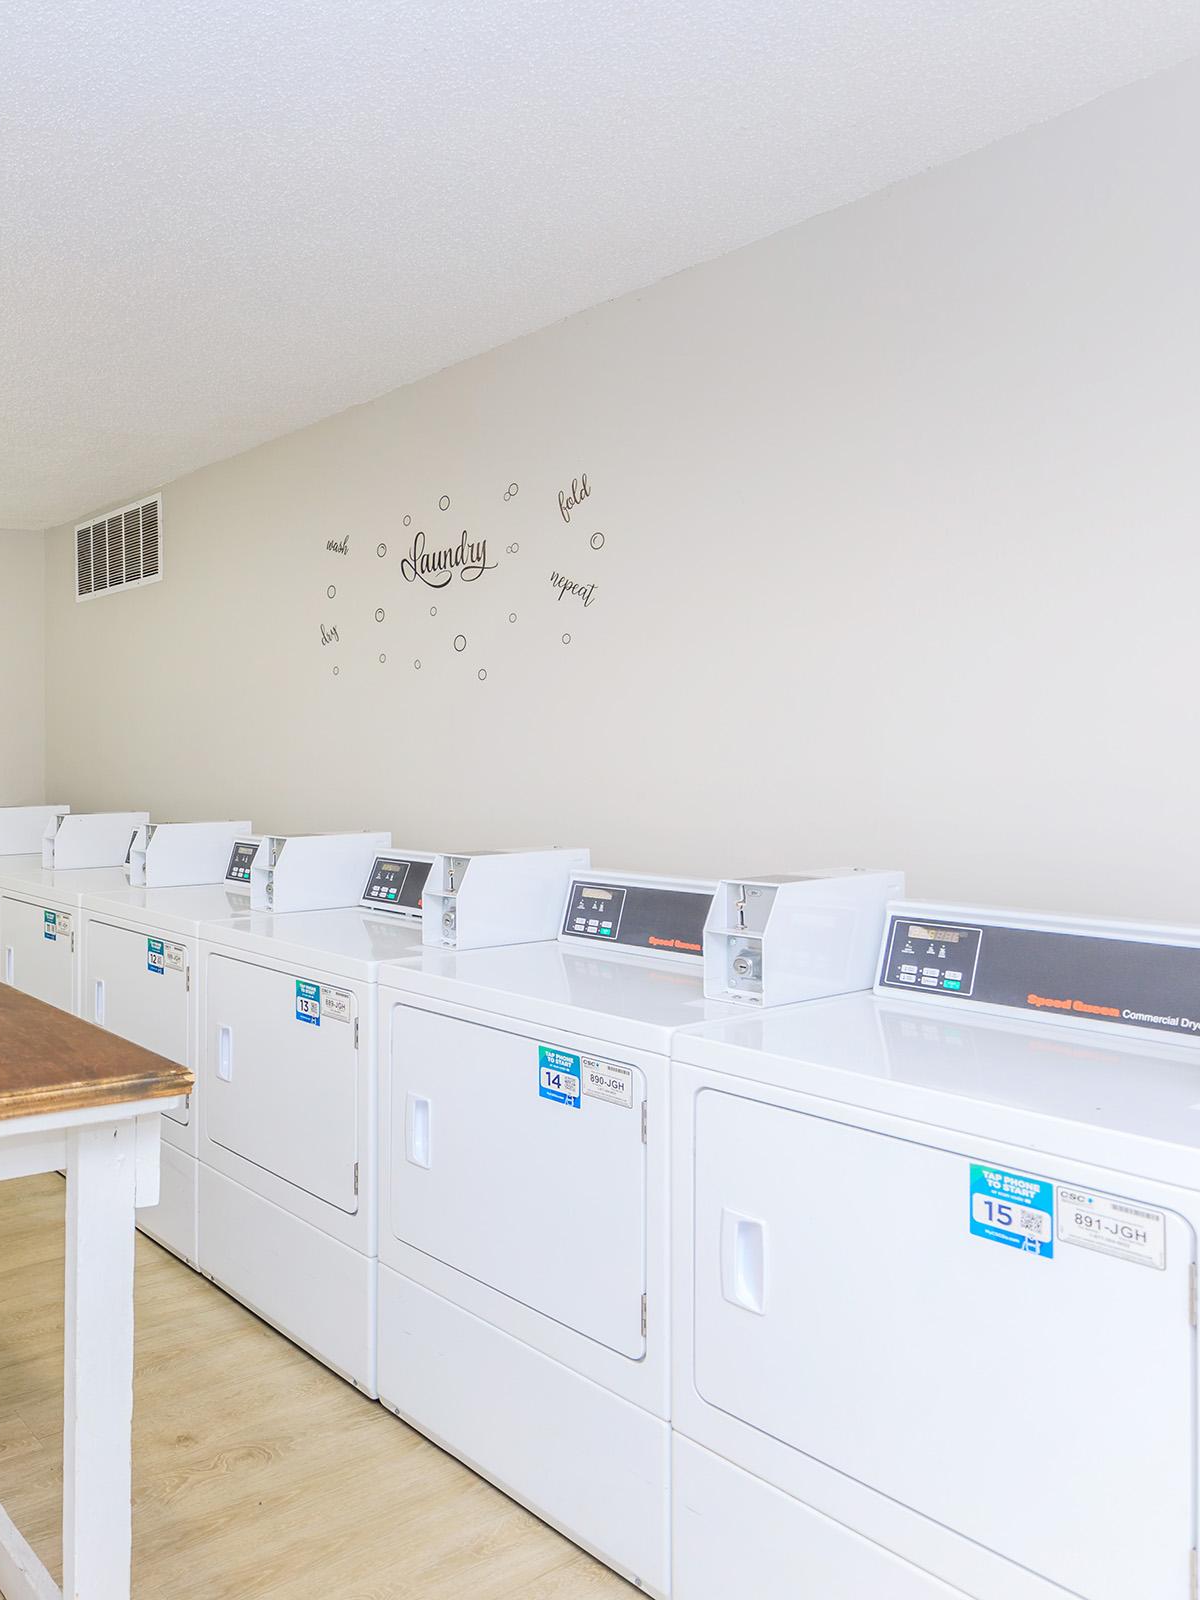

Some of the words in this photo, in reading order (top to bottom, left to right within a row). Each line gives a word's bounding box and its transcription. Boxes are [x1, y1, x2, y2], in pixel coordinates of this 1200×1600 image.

[558, 473, 591, 523] fold
[326, 535, 349, 556] wash
[400, 530, 499, 588] Laundry
[550, 571, 598, 607] repeat
[320, 623, 339, 646] dry
[150, 953, 157, 964] 12
[299, 999, 309, 1012] 13
[1027, 993, 1072, 1009] Speed
[1122, 1009, 1179, 1026] Commercial
[545, 1071, 562, 1089] 14
[590, 1073, 625, 1091] 890-JGH
[982, 1170, 1003, 1181] TAP
[1004, 1176, 1041, 1193] PHONE
[987, 1179, 1002, 1189] TO
[1003, 1184, 1037, 1199] START
[1060, 1191, 1086, 1203] CSC
[983, 1200, 1013, 1226] 15
[1074, 1213, 1148, 1243] 891-JGH
